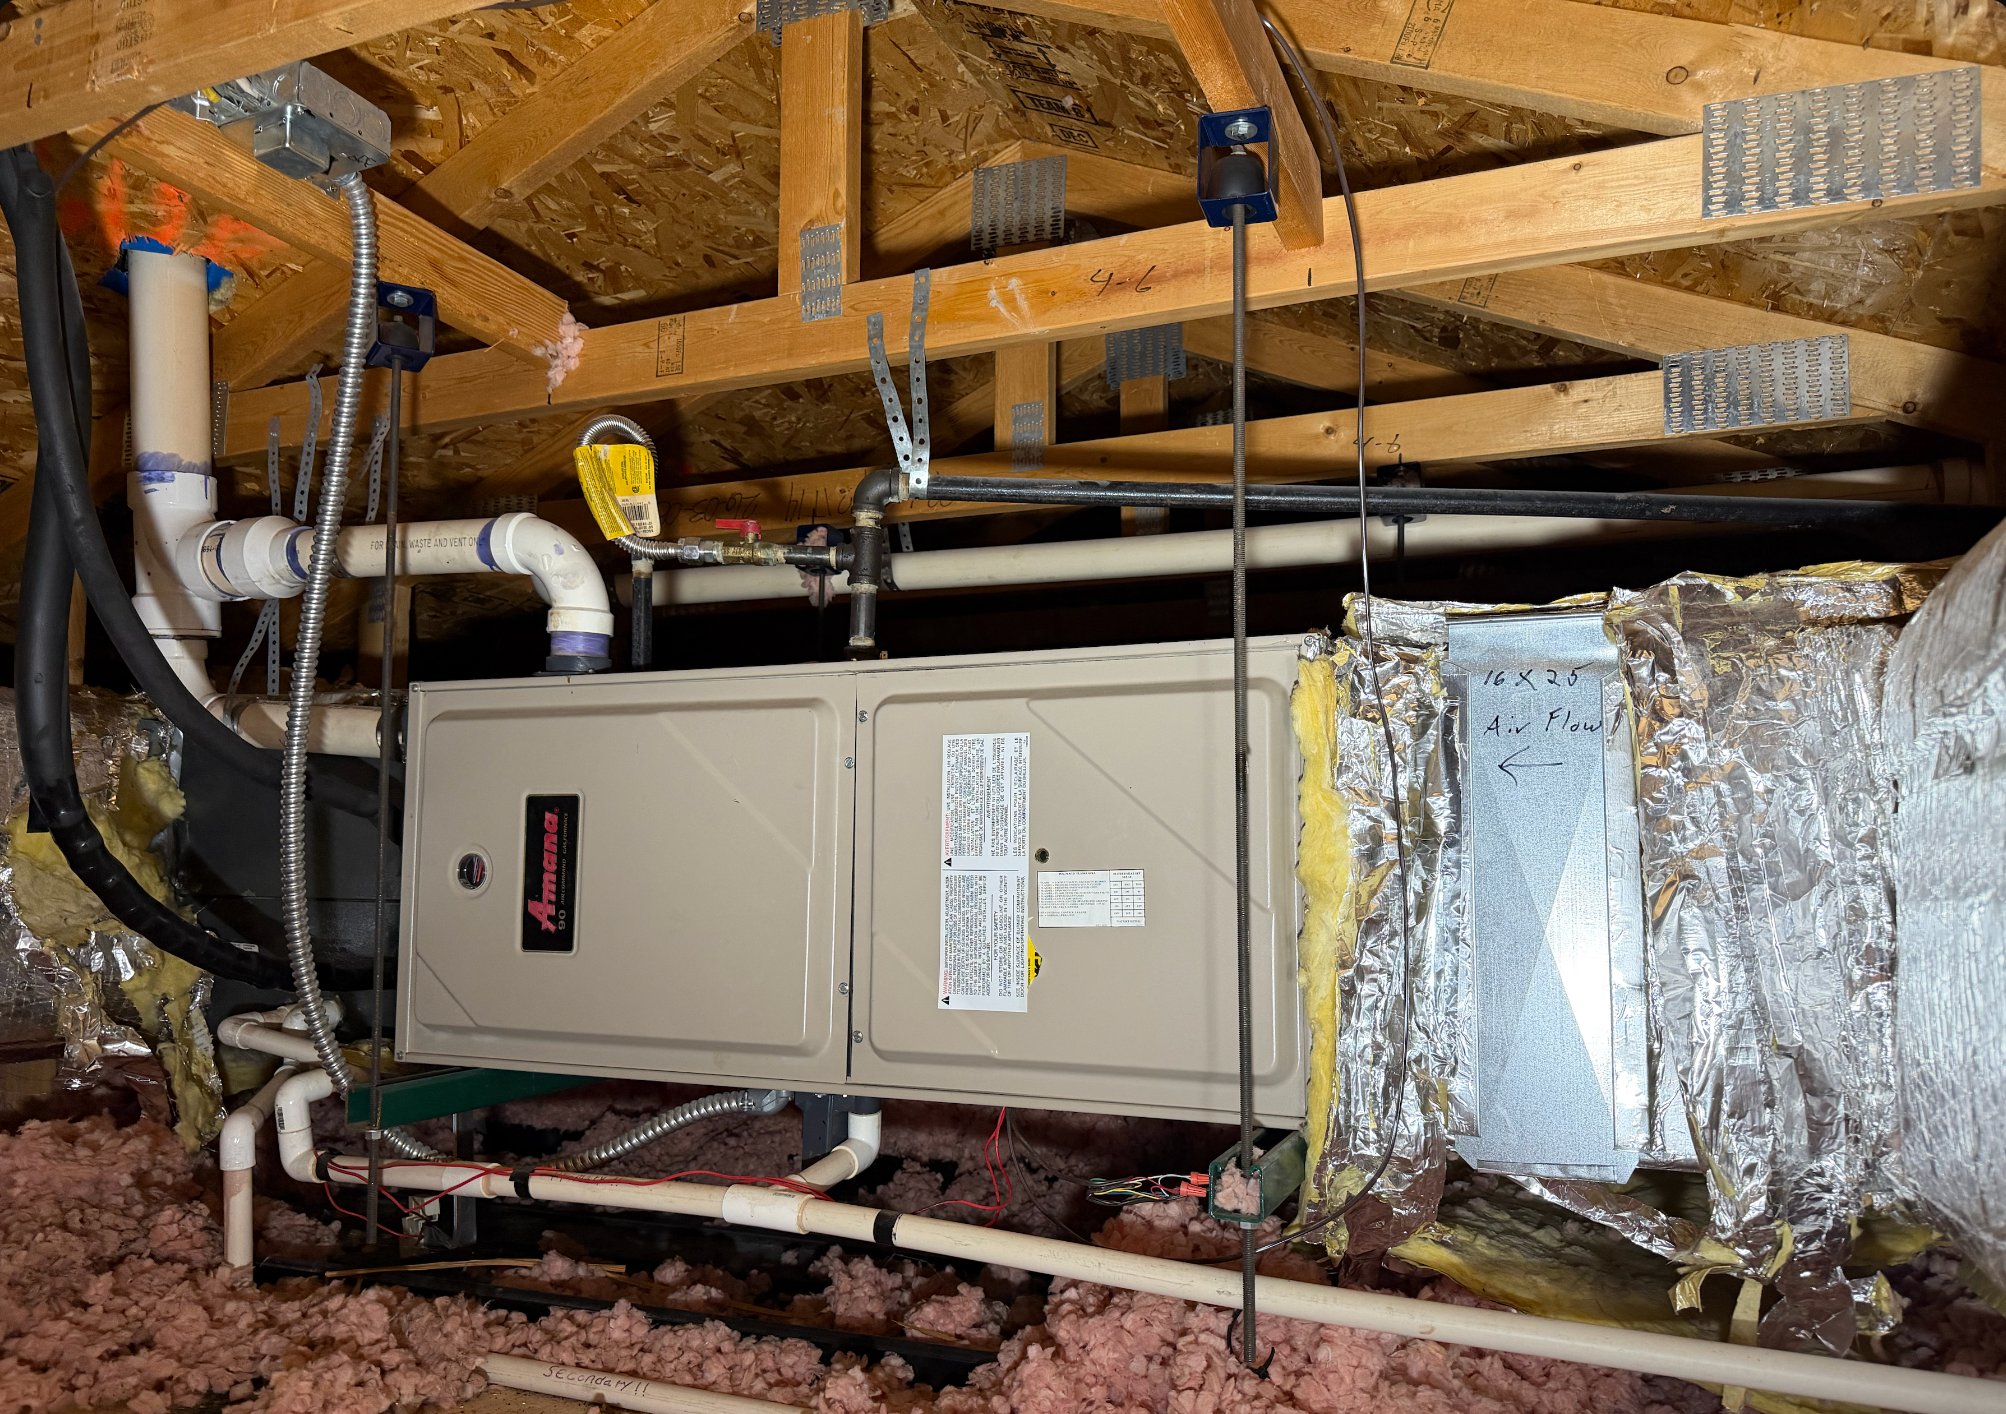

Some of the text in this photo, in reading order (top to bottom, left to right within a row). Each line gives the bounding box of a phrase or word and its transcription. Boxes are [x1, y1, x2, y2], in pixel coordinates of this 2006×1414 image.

[1059, 128, 1090, 144] DEC
[370, 541, 384, 550] FOR
[408, 538, 432, 549] WASTE
[433, 538, 448, 548] AND
[449, 536, 468, 547] VENT
[1484, 670, 1505, 686] 16
[1546, 662, 1594, 687] 25
[1483, 707, 1602, 737] Air Flow
[528, 811, 558, 934] Amana
[558, 910, 566, 930] 90
